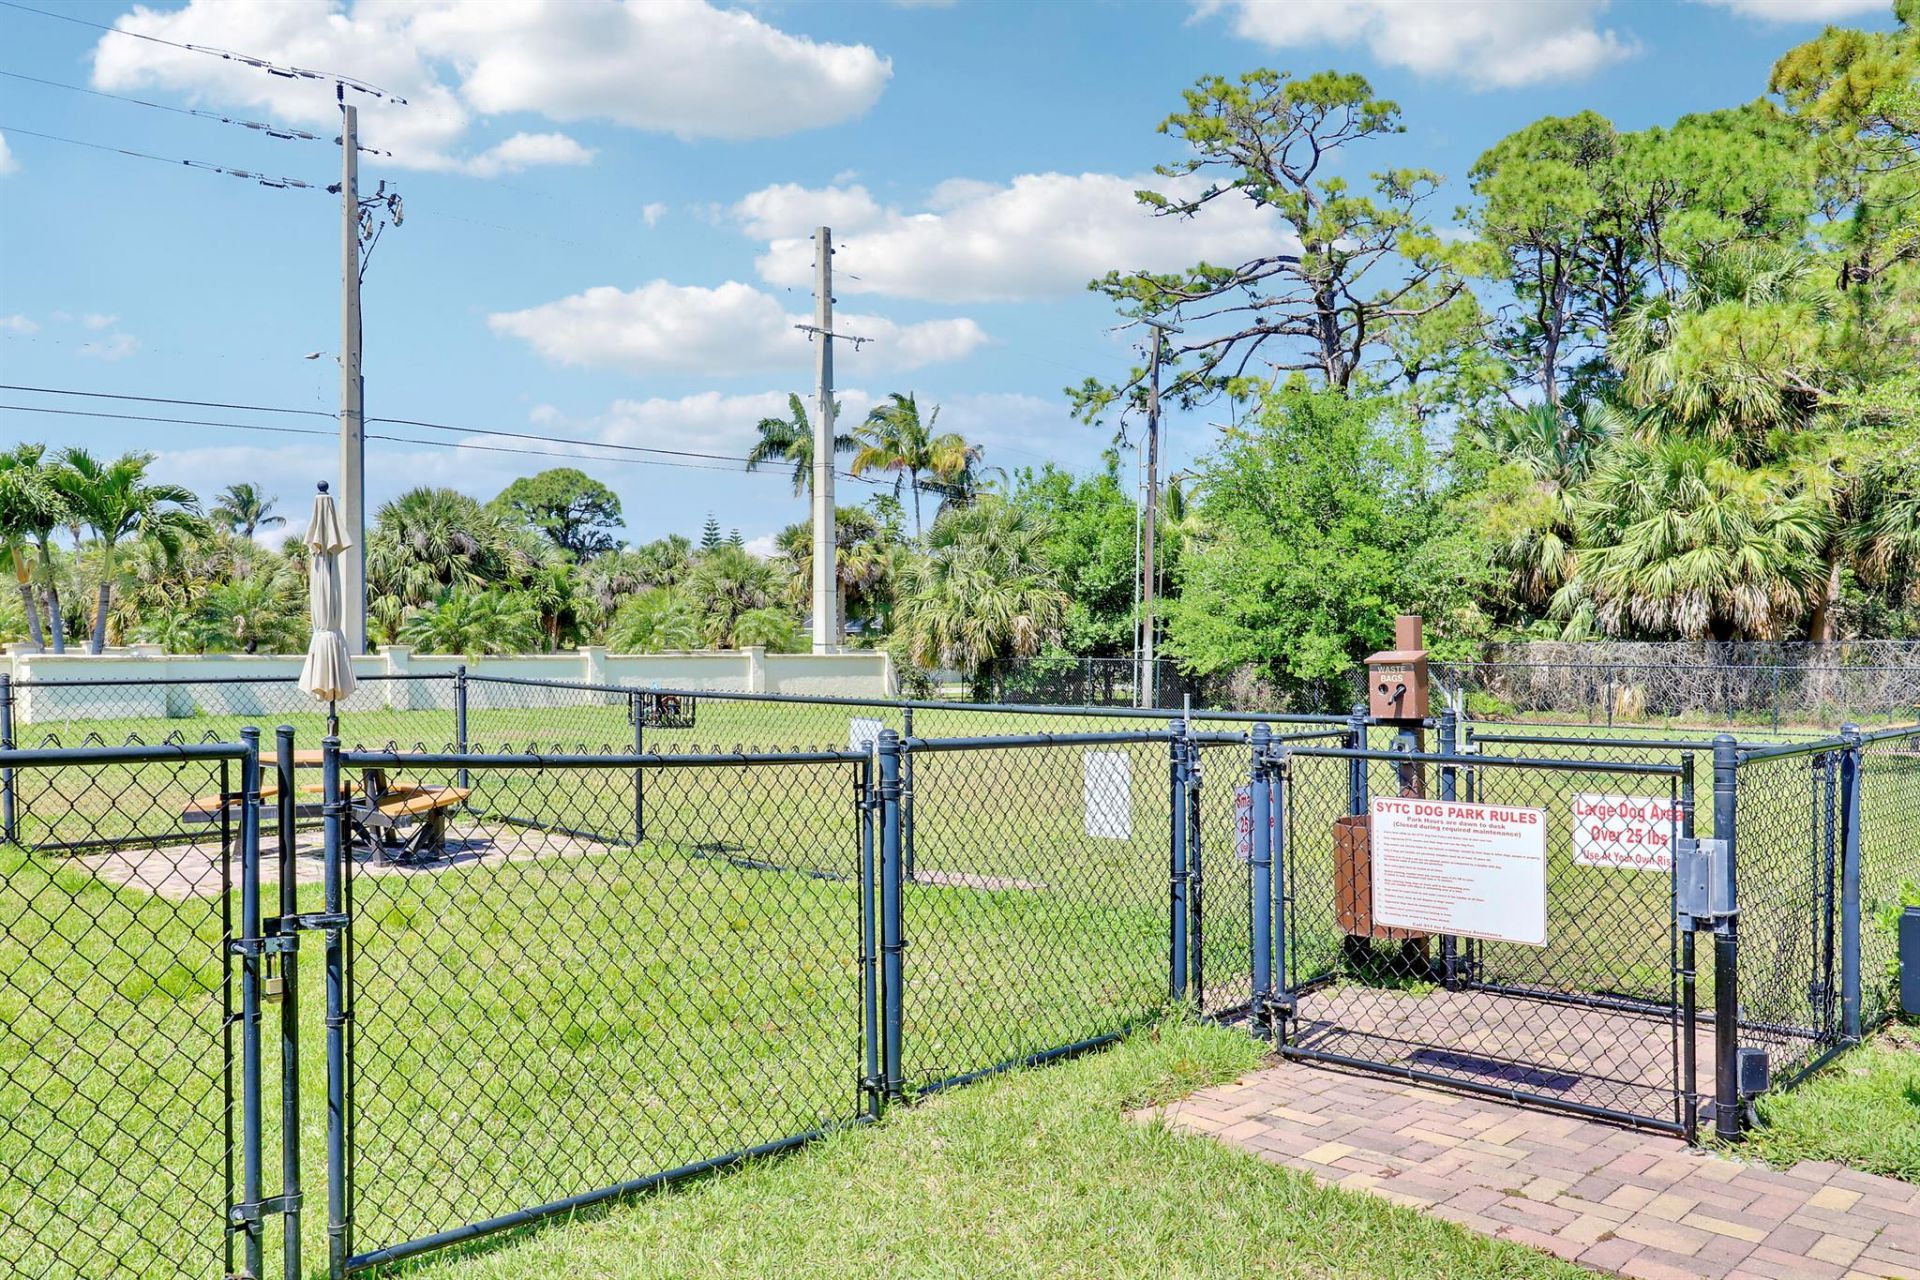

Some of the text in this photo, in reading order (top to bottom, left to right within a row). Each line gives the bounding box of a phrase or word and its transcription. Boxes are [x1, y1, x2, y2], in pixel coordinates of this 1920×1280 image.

[1377, 665, 1406, 673] WASTE
[1380, 674, 1404, 682] BAGS
[1376, 802, 1537, 824] SYTC DOG PARK RULES
[1576, 800, 1684, 823] Large Dog Area
[1393, 821, 1418, 829] (Closed
[1419, 823, 1440, 831] during
[1442, 826, 1471, 834] required
[1472, 828, 1521, 838] maintenance)
[1424, 817, 1444, 825] Hours
[1459, 820, 1478, 828] dawn
[1591, 825, 1668, 846] Over 25 lbs
[1583, 850, 1600, 860] Use
[1614, 852, 1633, 861] Your
[1635, 854, 1654, 864] Own
[1657, 855, 1671, 866] Ris
